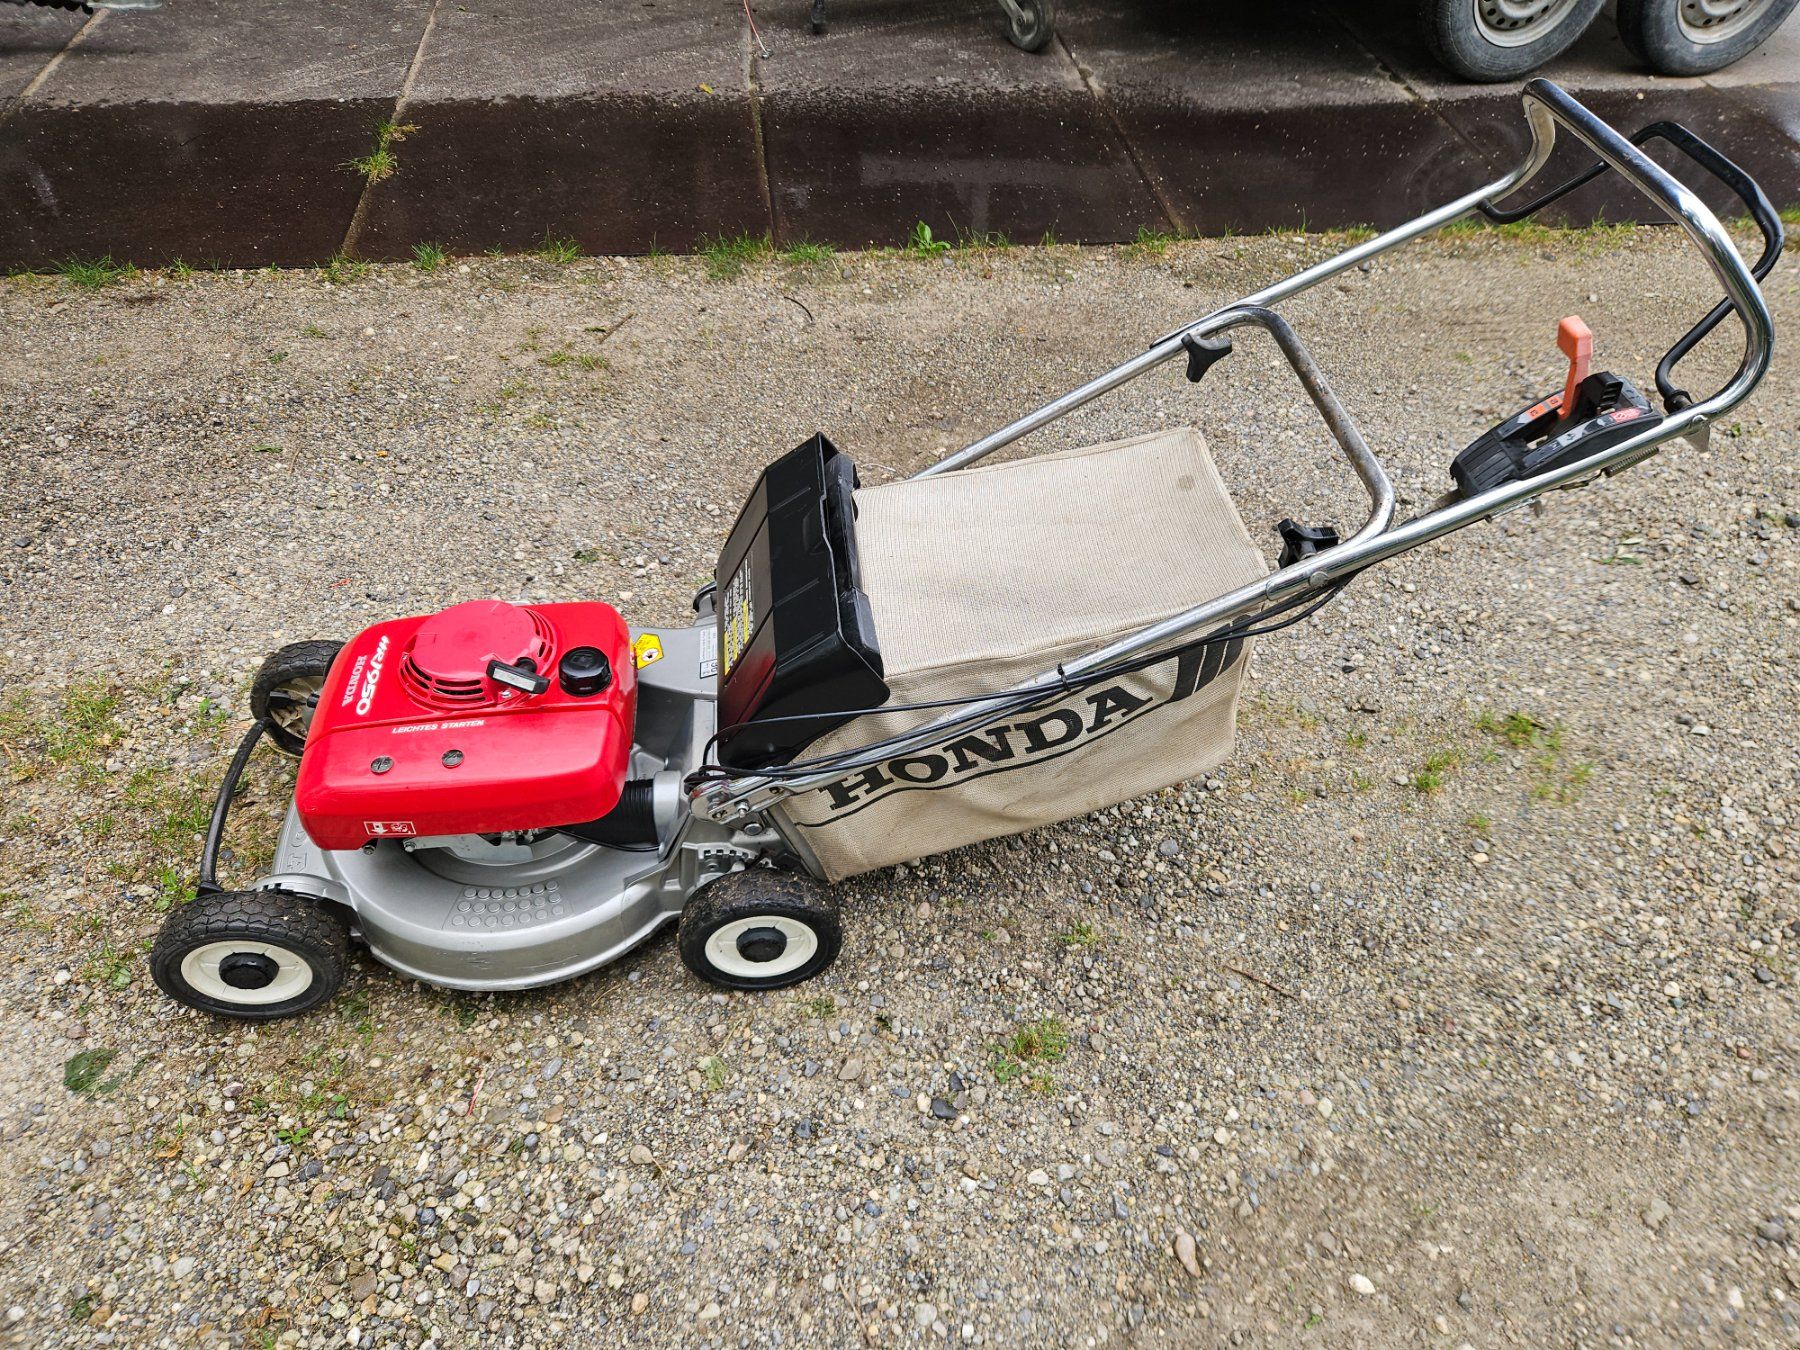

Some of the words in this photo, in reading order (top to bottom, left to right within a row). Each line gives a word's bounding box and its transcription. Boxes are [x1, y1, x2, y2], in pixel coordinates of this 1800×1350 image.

[341, 655, 367, 707] HONDA
[392, 723, 438, 734] LEICHTES
[441, 719, 484, 729] STARTEN
[818, 685, 1153, 811] HONDA
